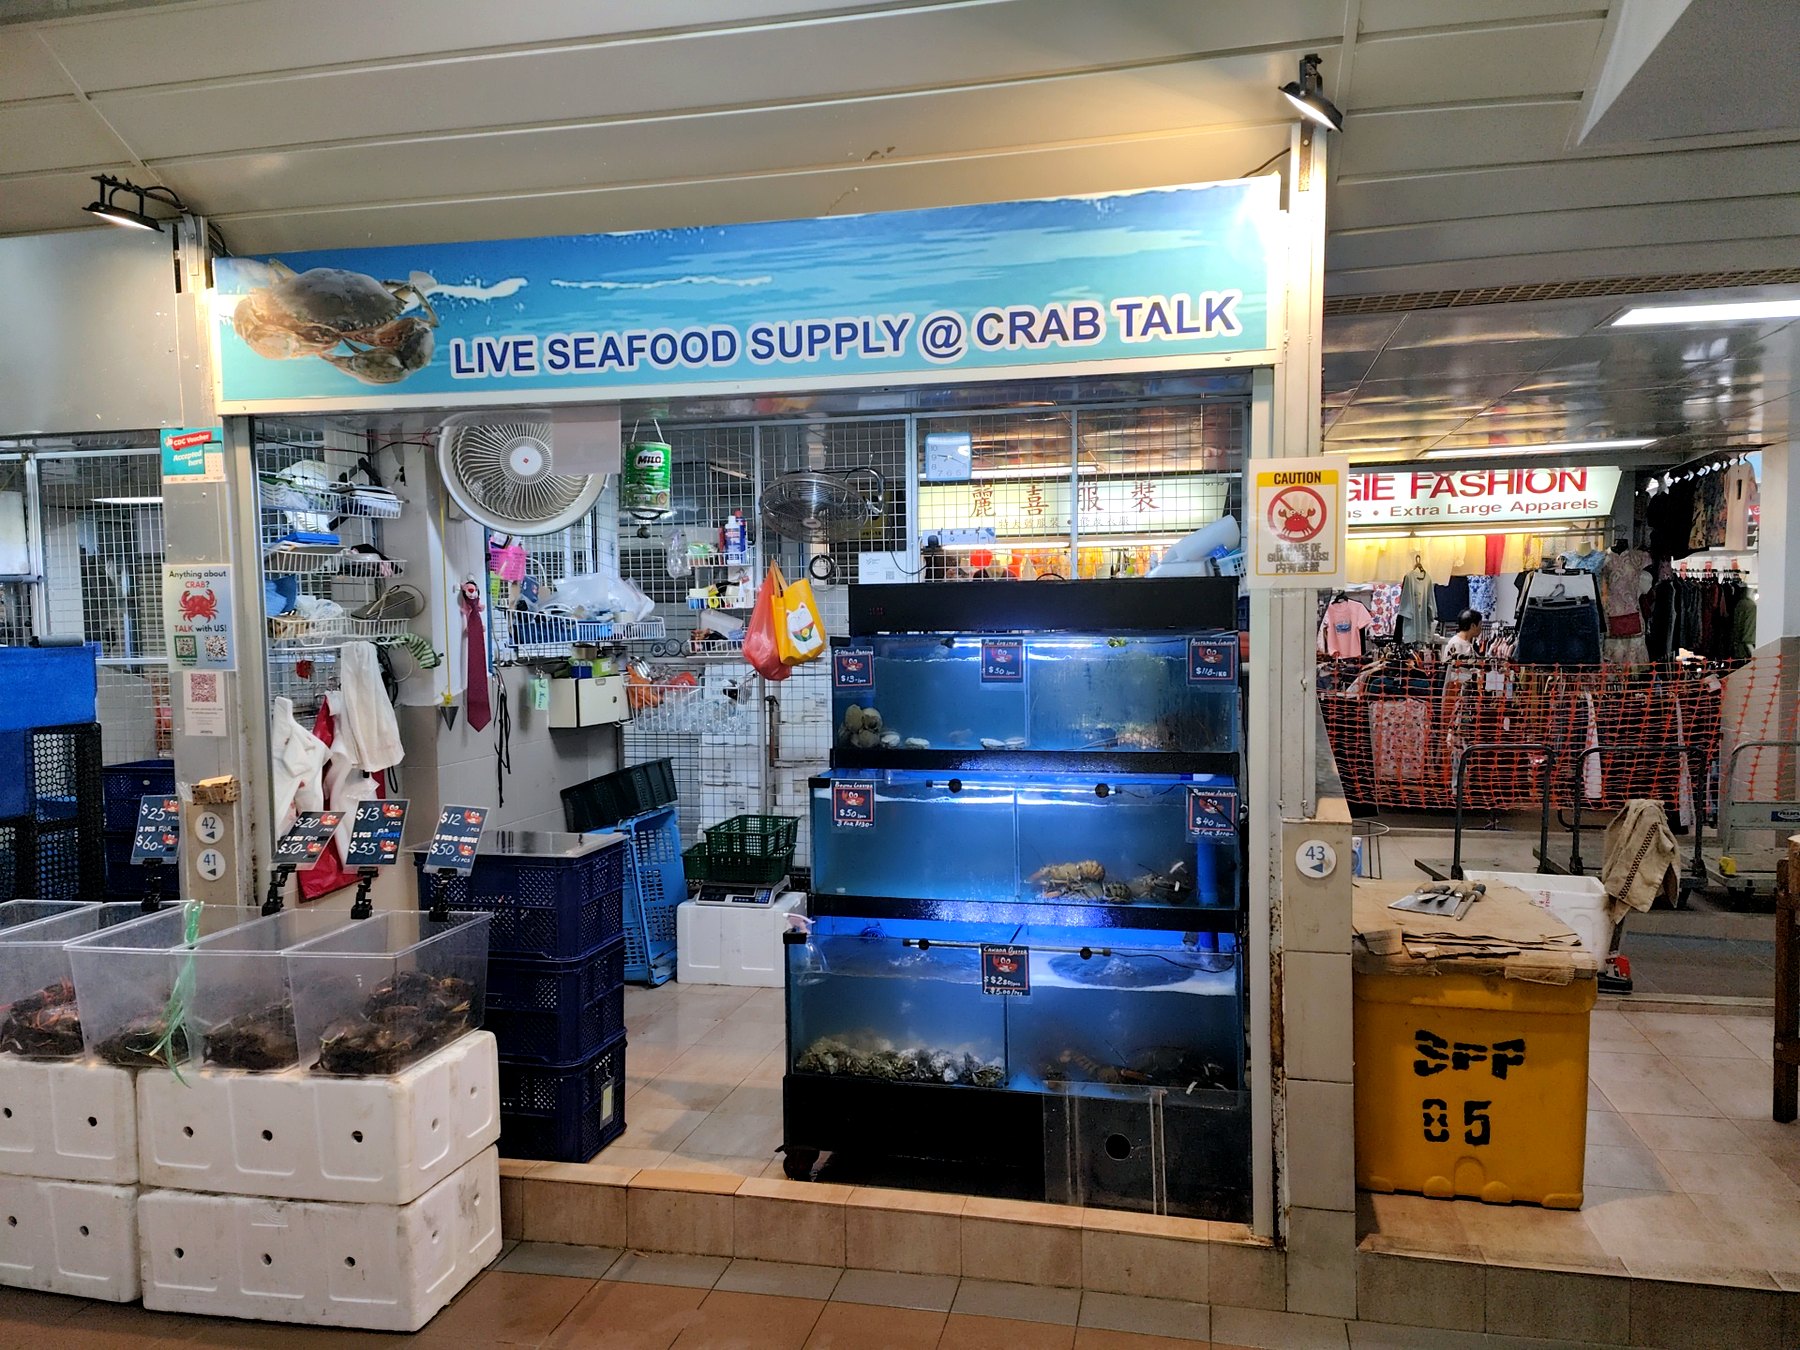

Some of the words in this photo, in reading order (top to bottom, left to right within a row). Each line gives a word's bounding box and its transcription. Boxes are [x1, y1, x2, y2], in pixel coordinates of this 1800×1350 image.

[452, 339, 537, 375] LIVE
[547, 327, 738, 370] SEAFOOD
[749, 316, 911, 362] SUPPLY
[920, 314, 964, 359] @
[975, 304, 1102, 346] CRAB
[1115, 294, 1237, 338] TALK
[186, 434, 210, 444] Voucher
[173, 449, 203, 462] Accepted
[637, 455, 662, 465] MILO
[188, 458, 203, 467] here
[1273, 472, 1322, 485] CAUTION
[1410, 467, 1588, 500] FASHION
[1390, 505, 1440, 517] Extra
[1447, 503, 1502, 516] Large
[1510, 498, 1599, 514] Apparels
[1267, 552, 1297, 563] GUA
[1298, 551, 1330, 562] RABS!
[168, 570, 203, 580] Anything
[203, 570, 227, 579] about
[185, 580, 211, 589] CRAB?
[174, 624, 195, 633] TALK
[195, 624, 213, 633] with
[214, 624, 227, 633] US!
[140, 803, 167, 821] $25
[355, 807, 380, 821] $13
[440, 811, 462, 826] $12
[839, 808, 857, 818] $50
[201, 816, 217, 830] 42
[294, 817, 321, 829] $20
[1195, 816, 1215, 827] $40
[348, 841, 378, 855] $55
[430, 842, 455, 856] $50
[1305, 845, 1326, 861] 43
[202, 853, 217, 866] 41
